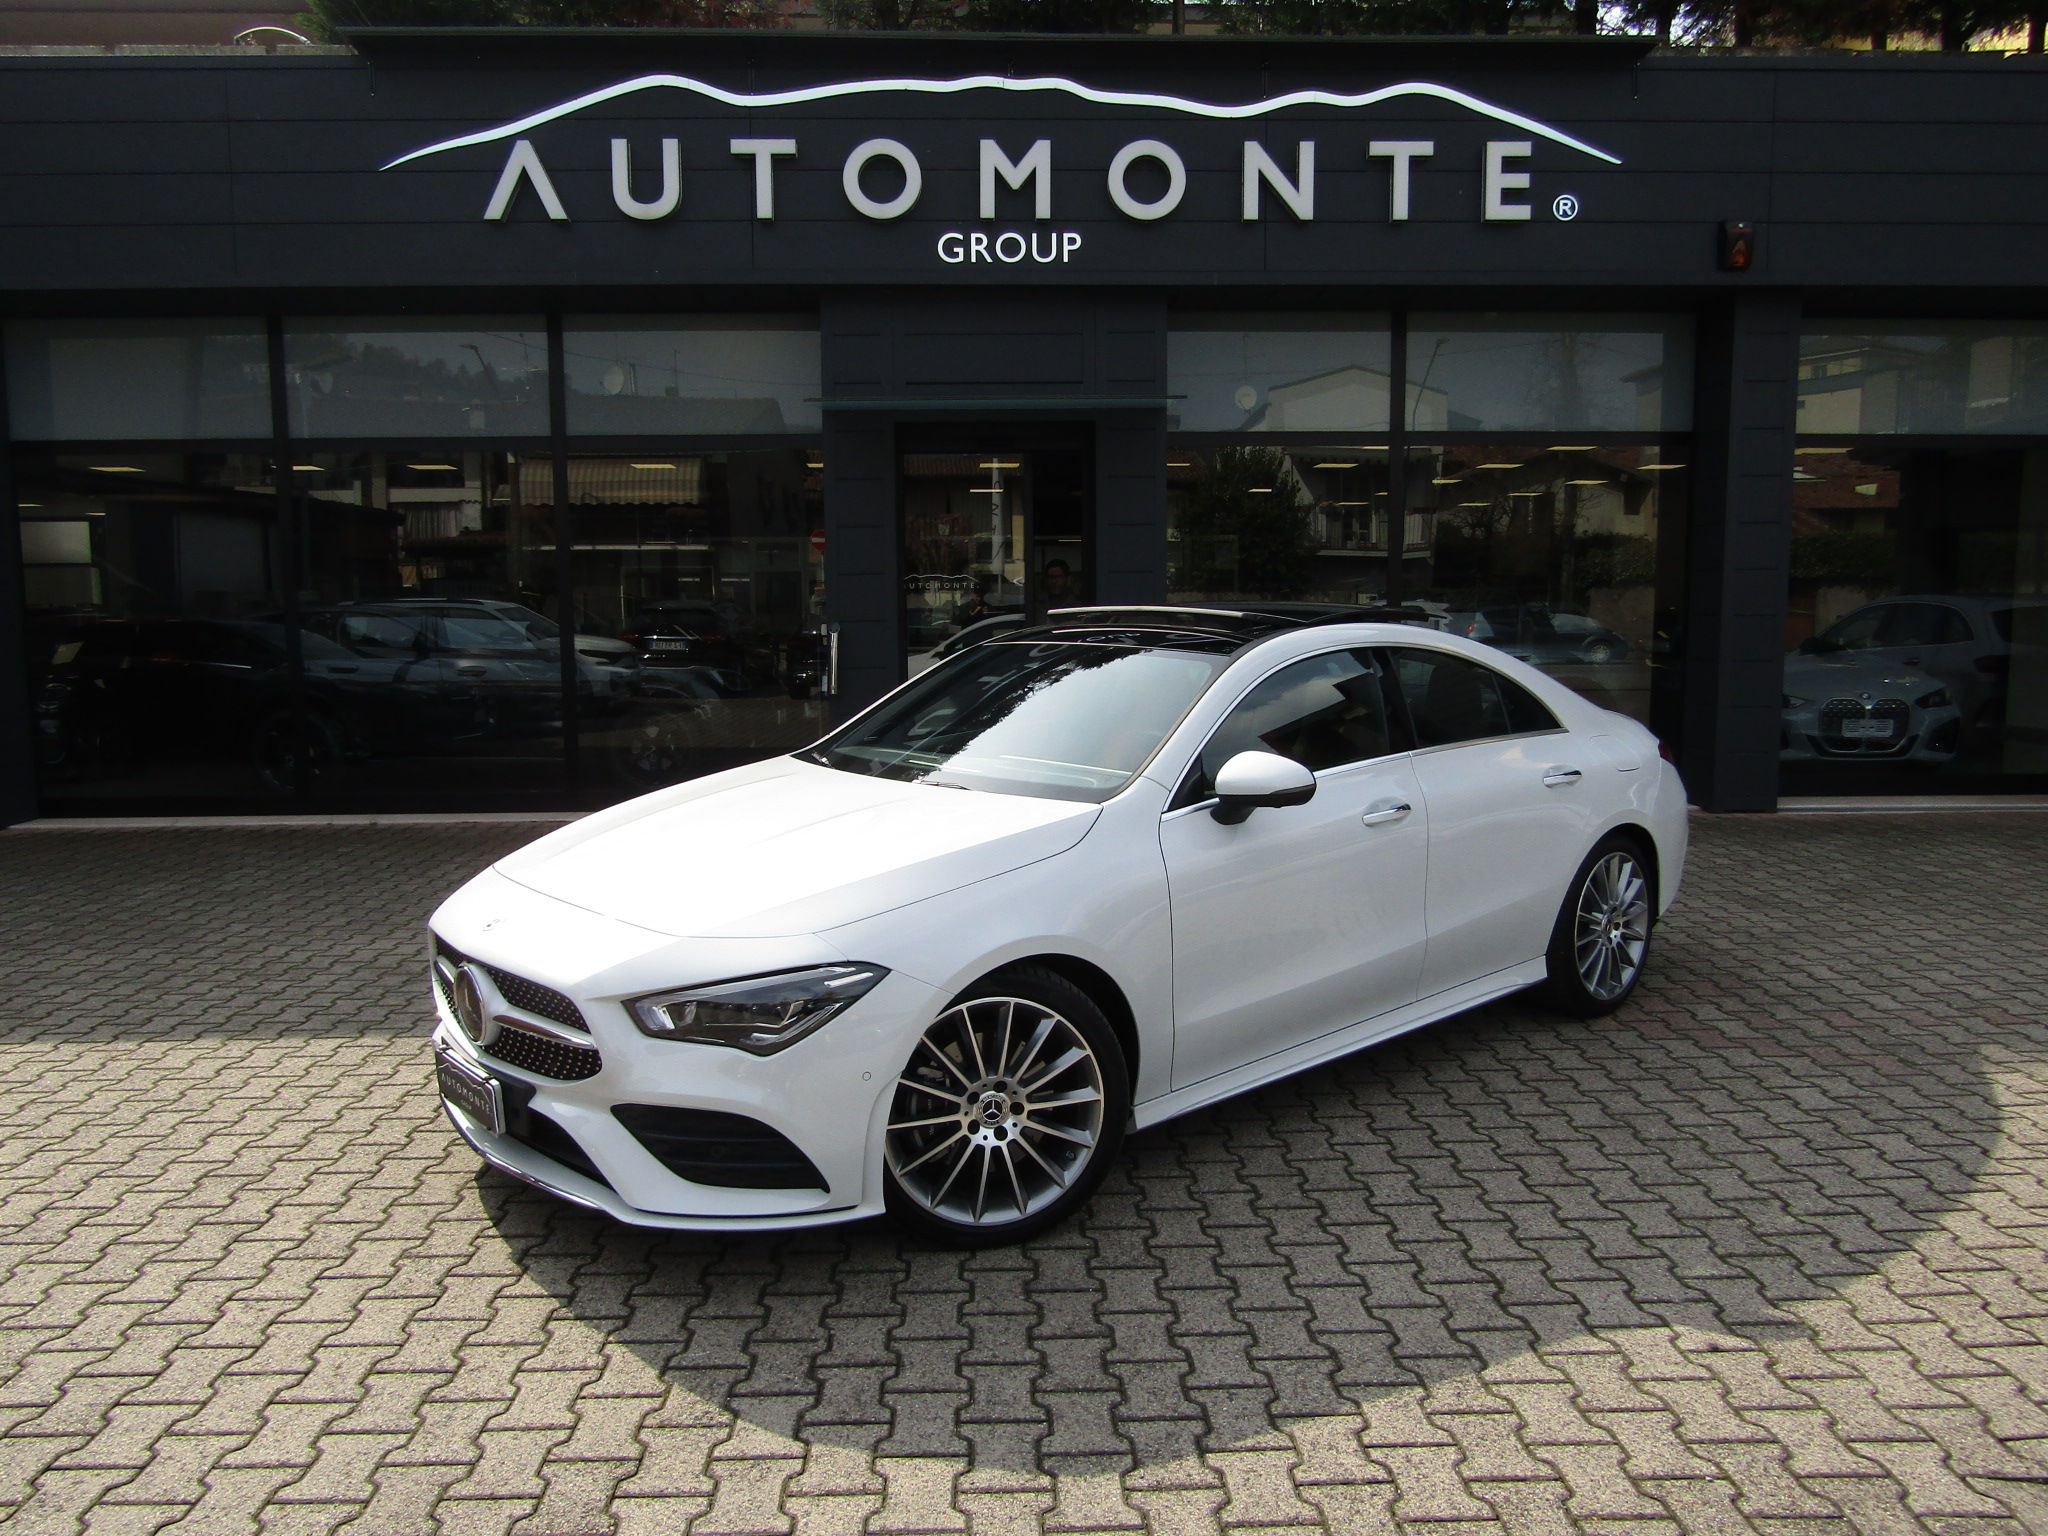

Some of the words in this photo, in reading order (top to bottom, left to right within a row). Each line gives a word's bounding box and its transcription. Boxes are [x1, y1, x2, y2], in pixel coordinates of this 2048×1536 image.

[483, 137, 1532, 221] AUTOMONTE
[937, 231, 1082, 264] GROUP
[441, 1072, 490, 1115] AUTOMONTE
